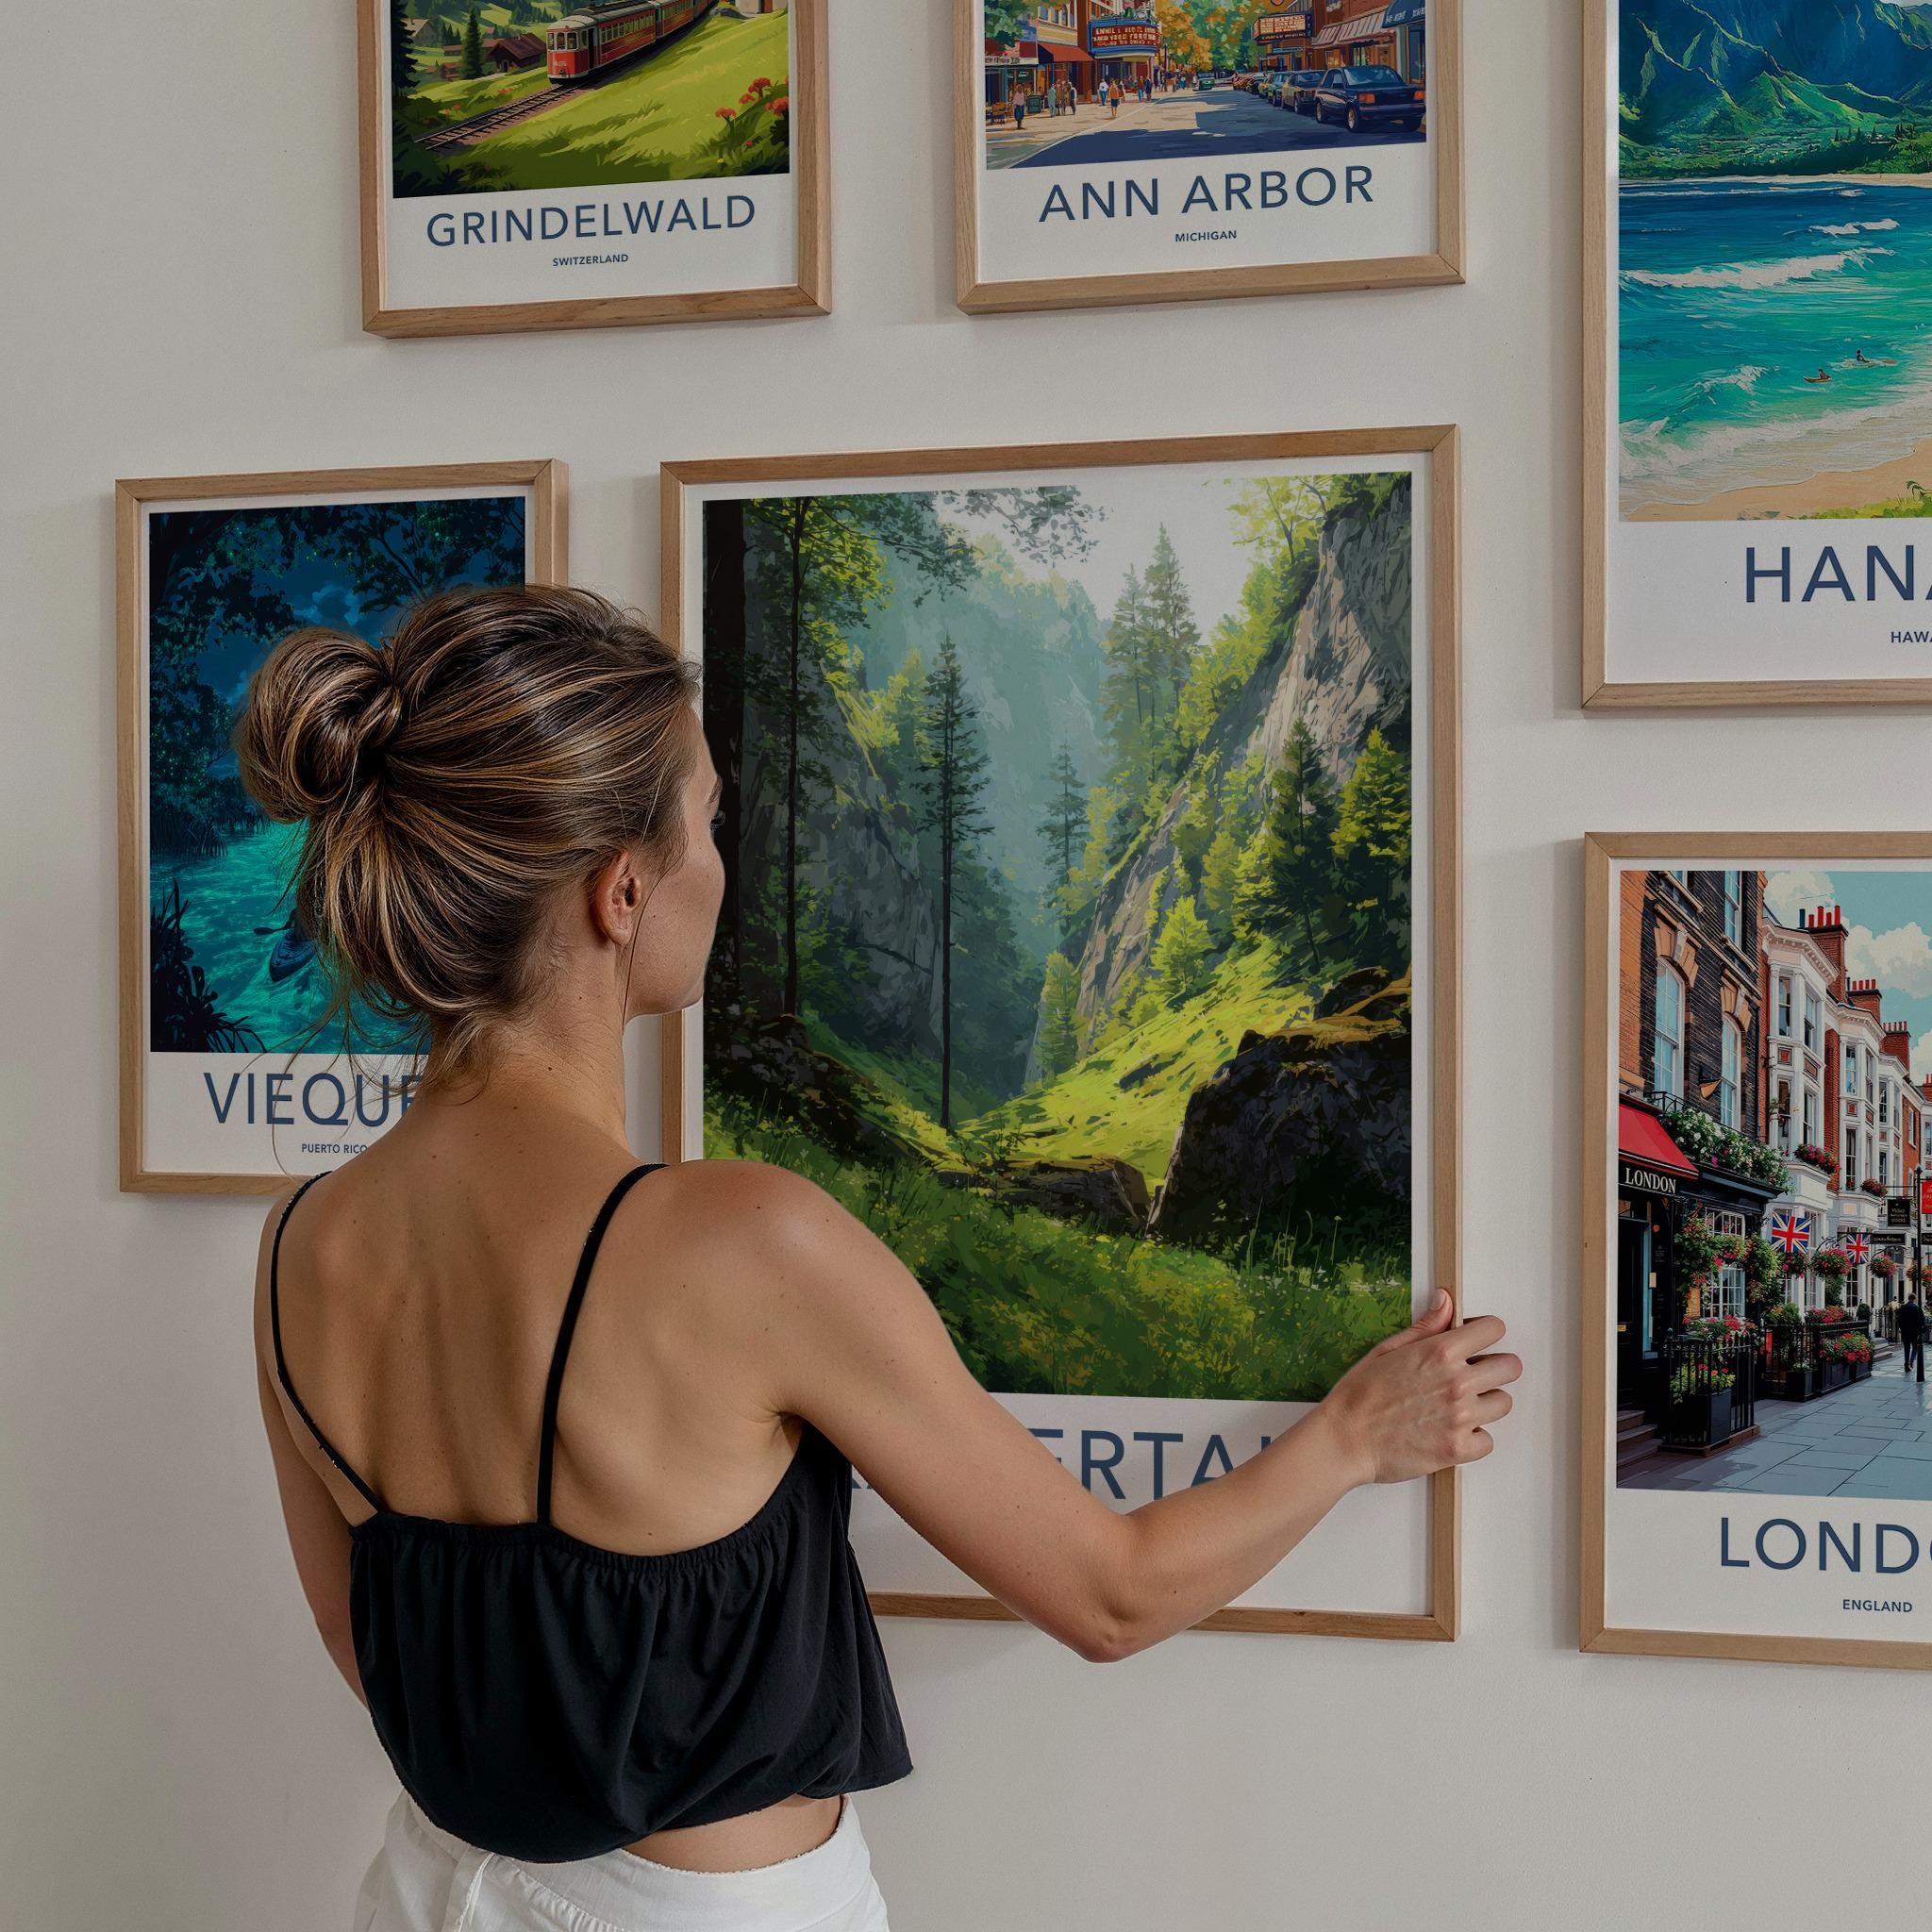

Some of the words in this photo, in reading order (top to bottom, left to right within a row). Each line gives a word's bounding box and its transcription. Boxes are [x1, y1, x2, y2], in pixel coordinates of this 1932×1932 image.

[1039, 177, 1158, 223] ANN
[1181, 165, 1374, 213] ARBOR
[427, 195, 755, 247] GRINDELWALD
[1175, 229, 1237, 242] MICHIGAN
[553, 254, 628, 267] SWITZERLAND
[1746, 544, 1932, 603] HAN
[301, 1142, 341, 1154] PUERTO
[343, 1143, 368, 1154] RICO
[1625, 1167, 1676, 1194] LONDON
[1721, 1517, 1932, 1574] LOND
[1842, 1599, 1913, 1613] ENGLAND
